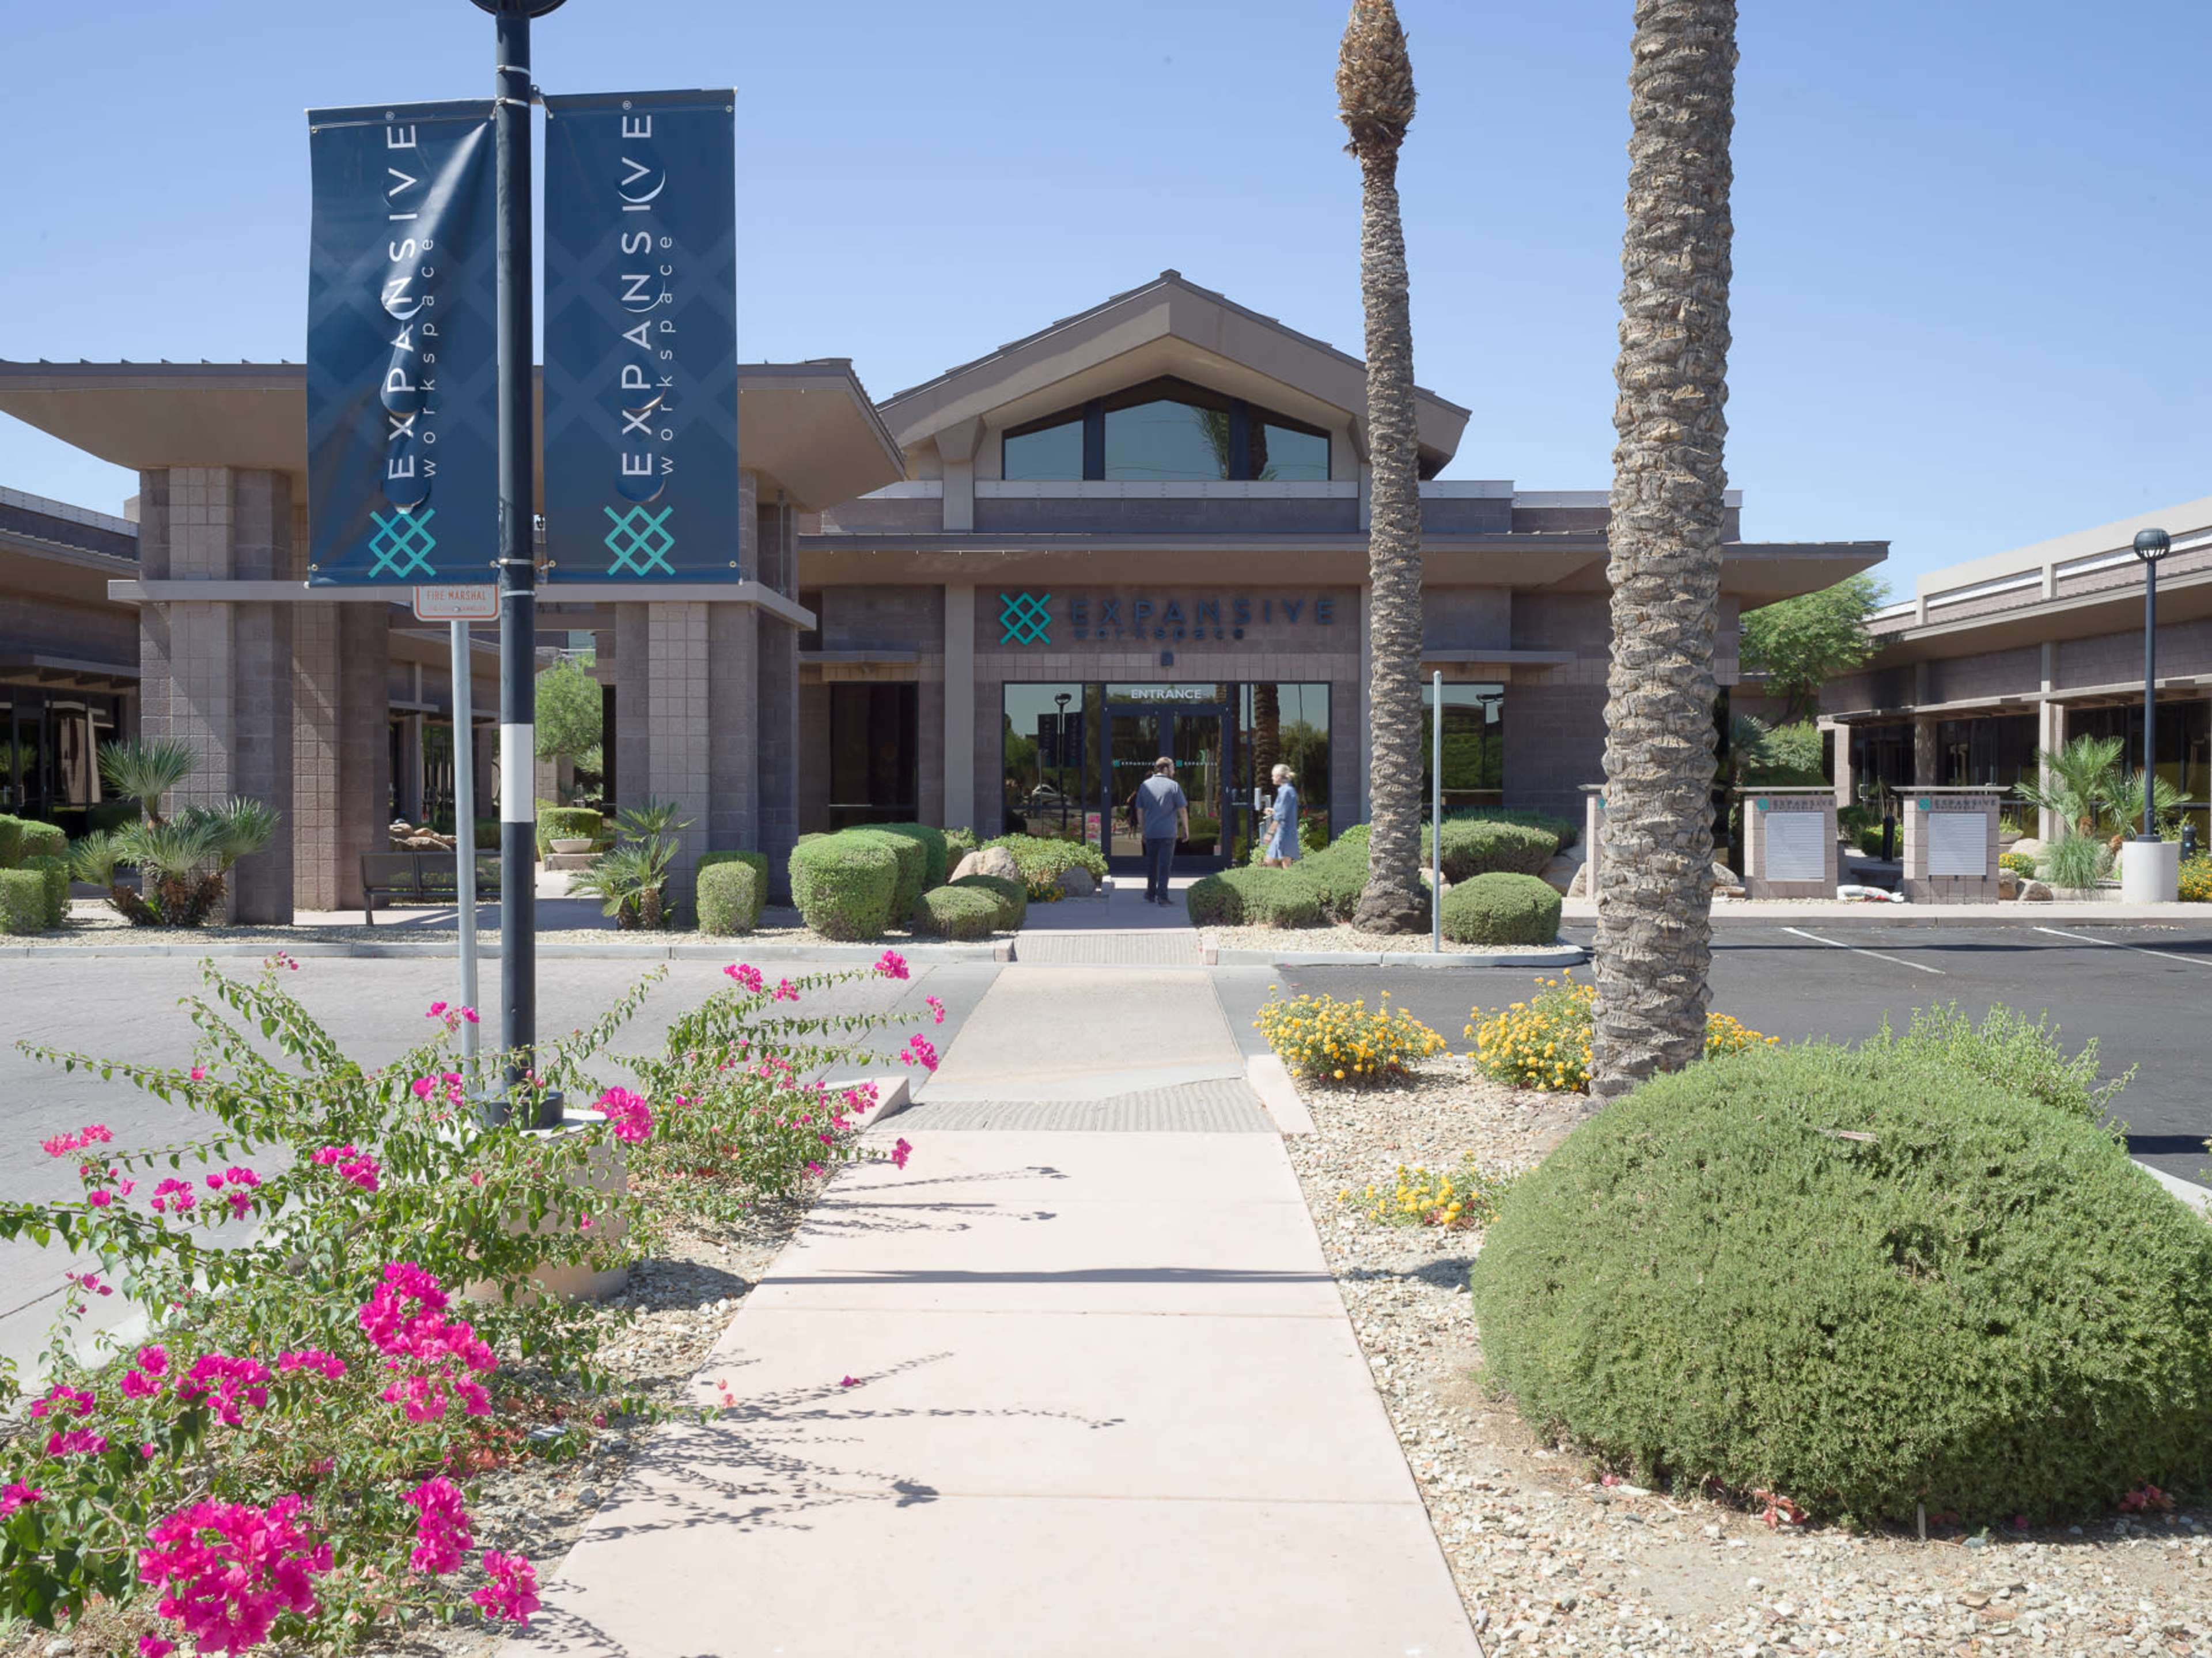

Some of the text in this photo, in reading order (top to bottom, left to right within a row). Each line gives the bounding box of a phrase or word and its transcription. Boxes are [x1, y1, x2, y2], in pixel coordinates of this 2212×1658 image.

[420, 239, 438, 478] workspace
[656, 236, 676, 475] workspace
[427, 589, 486, 600] FIRE MARSHAL
[1071, 599, 1336, 625] EXPANSIVE
[1131, 688, 1201, 700] ENTRANCE
